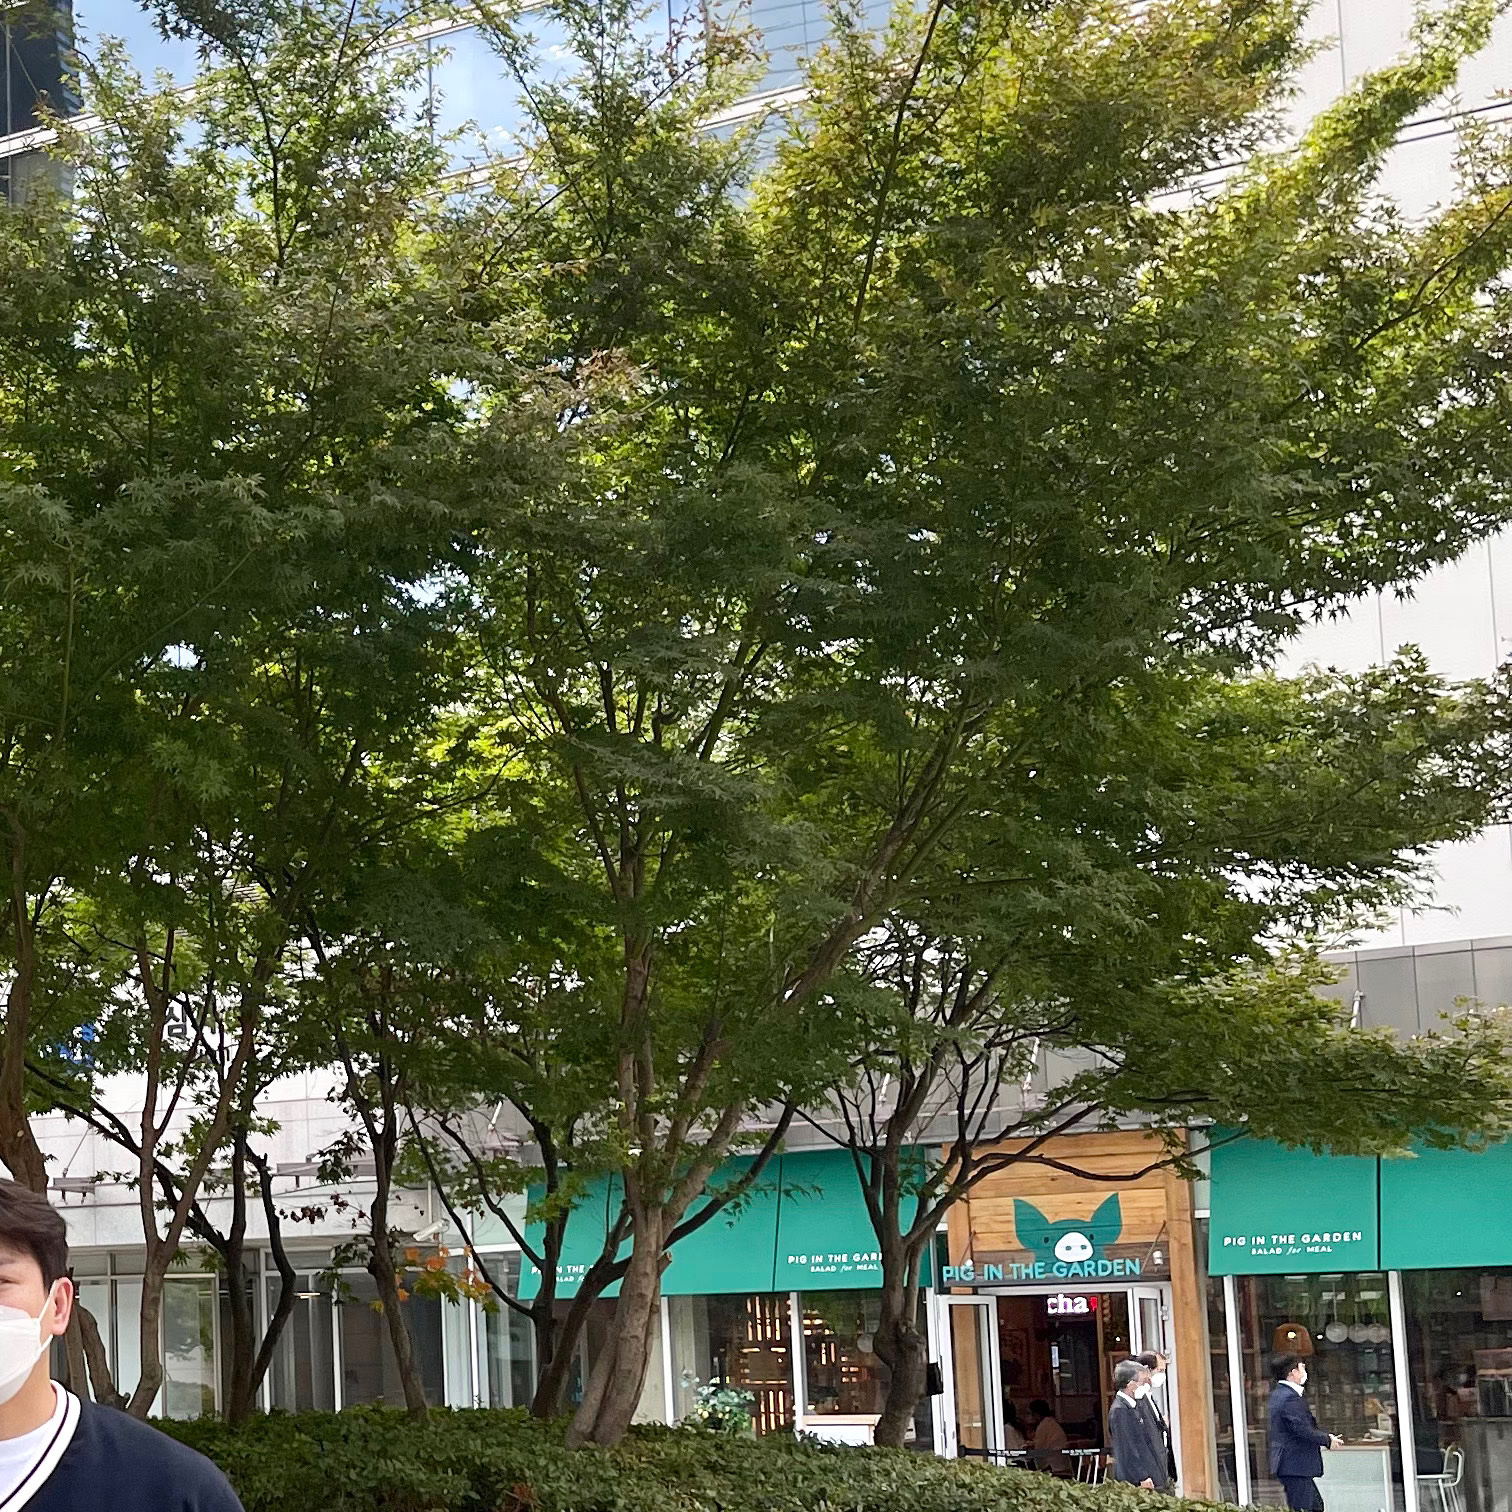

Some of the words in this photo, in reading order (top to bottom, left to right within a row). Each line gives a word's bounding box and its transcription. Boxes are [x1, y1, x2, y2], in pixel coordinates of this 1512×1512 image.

[1223, 1236, 1246, 1246] PIG
[1251, 1236, 1265, 1245] IN
[1271, 1234, 1295, 1244] THE
[1300, 1231, 1362, 1243] GARDEN
[1251, 1247, 1282, 1255] SALAD
[1286, 1246, 1301, 1255] for
[1306, 1245, 1332, 1253] MEAL
[787, 1255, 807, 1264] PIG
[811, 1254, 823, 1263] IN
[828, 1254, 848, 1263] THE
[566, 1264, 585, 1274] THE
[810, 1265, 837, 1273] SALAD
[840, 1265, 852, 1273] for
[856, 1263, 878, 1271] MEAL
[942, 1264, 975, 1282] PIG
[984, 1264, 1003, 1280] IN
[1009, 1262, 1046, 1280] THE
[1052, 1258, 1140, 1279] GARDEN
